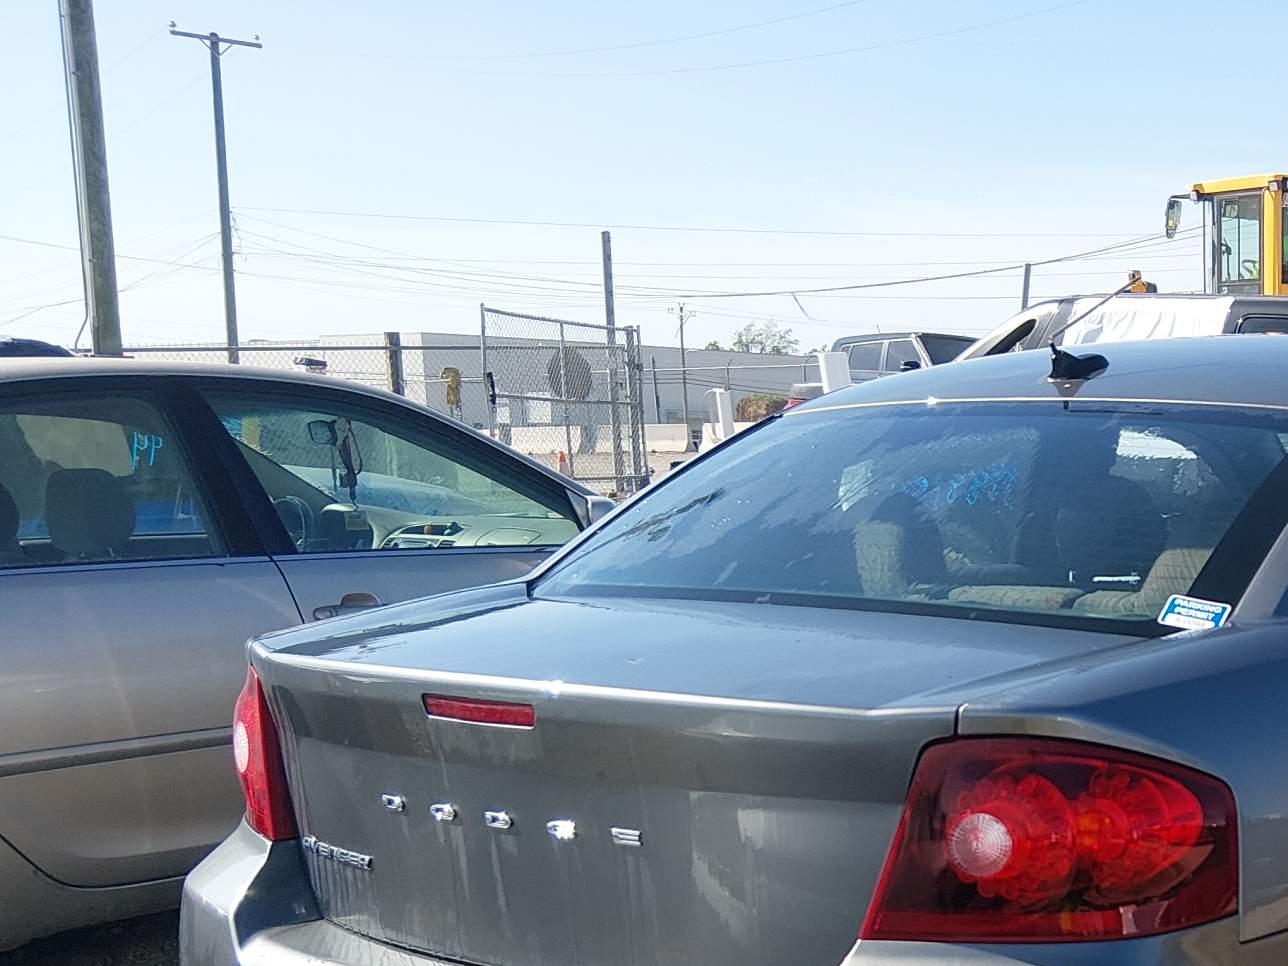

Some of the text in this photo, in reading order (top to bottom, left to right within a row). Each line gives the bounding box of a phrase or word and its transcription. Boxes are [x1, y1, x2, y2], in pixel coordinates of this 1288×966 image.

[1174, 598, 1223, 614] PARKING
[1174, 606, 1216, 621] PERMIT
[382, 794, 642, 847] DODGE
[303, 835, 374, 870] AVENGER
